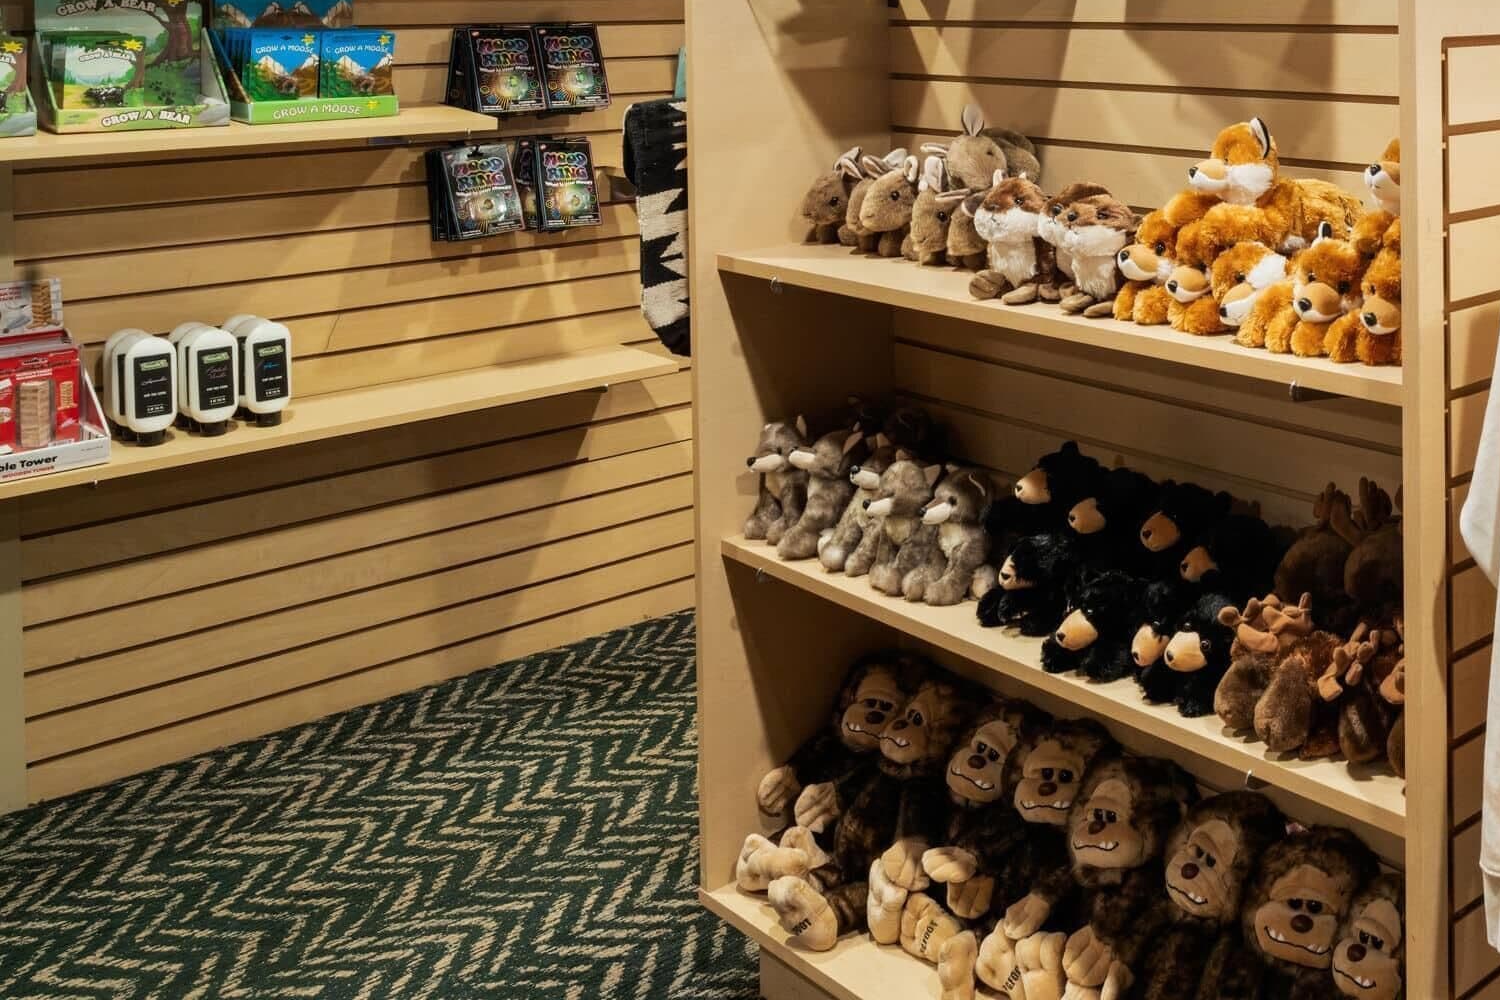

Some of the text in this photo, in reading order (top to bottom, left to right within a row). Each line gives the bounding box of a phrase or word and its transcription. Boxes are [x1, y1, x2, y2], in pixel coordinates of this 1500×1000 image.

[57, 0, 97, 16] GROW
[255, 45, 279, 54] GROW
[287, 44, 314, 53] MOOSE
[334, 45, 355, 54] GROW
[364, 44, 389, 53] MOOSE
[476, 38, 529, 53] MOOD
[543, 36, 594, 50] MOOD
[481, 52, 529, 66] RING
[548, 49, 594, 63] RING
[101, 110, 191, 128] GROW A BEAR
[272, 104, 361, 120] GROW A MOOSE
[452, 157, 505, 176] MOOD
[544, 152, 587, 167] MOOD
[547, 166, 589, 180] RING
[456, 172, 506, 190] RING
[20, 455, 58, 468] Tower
